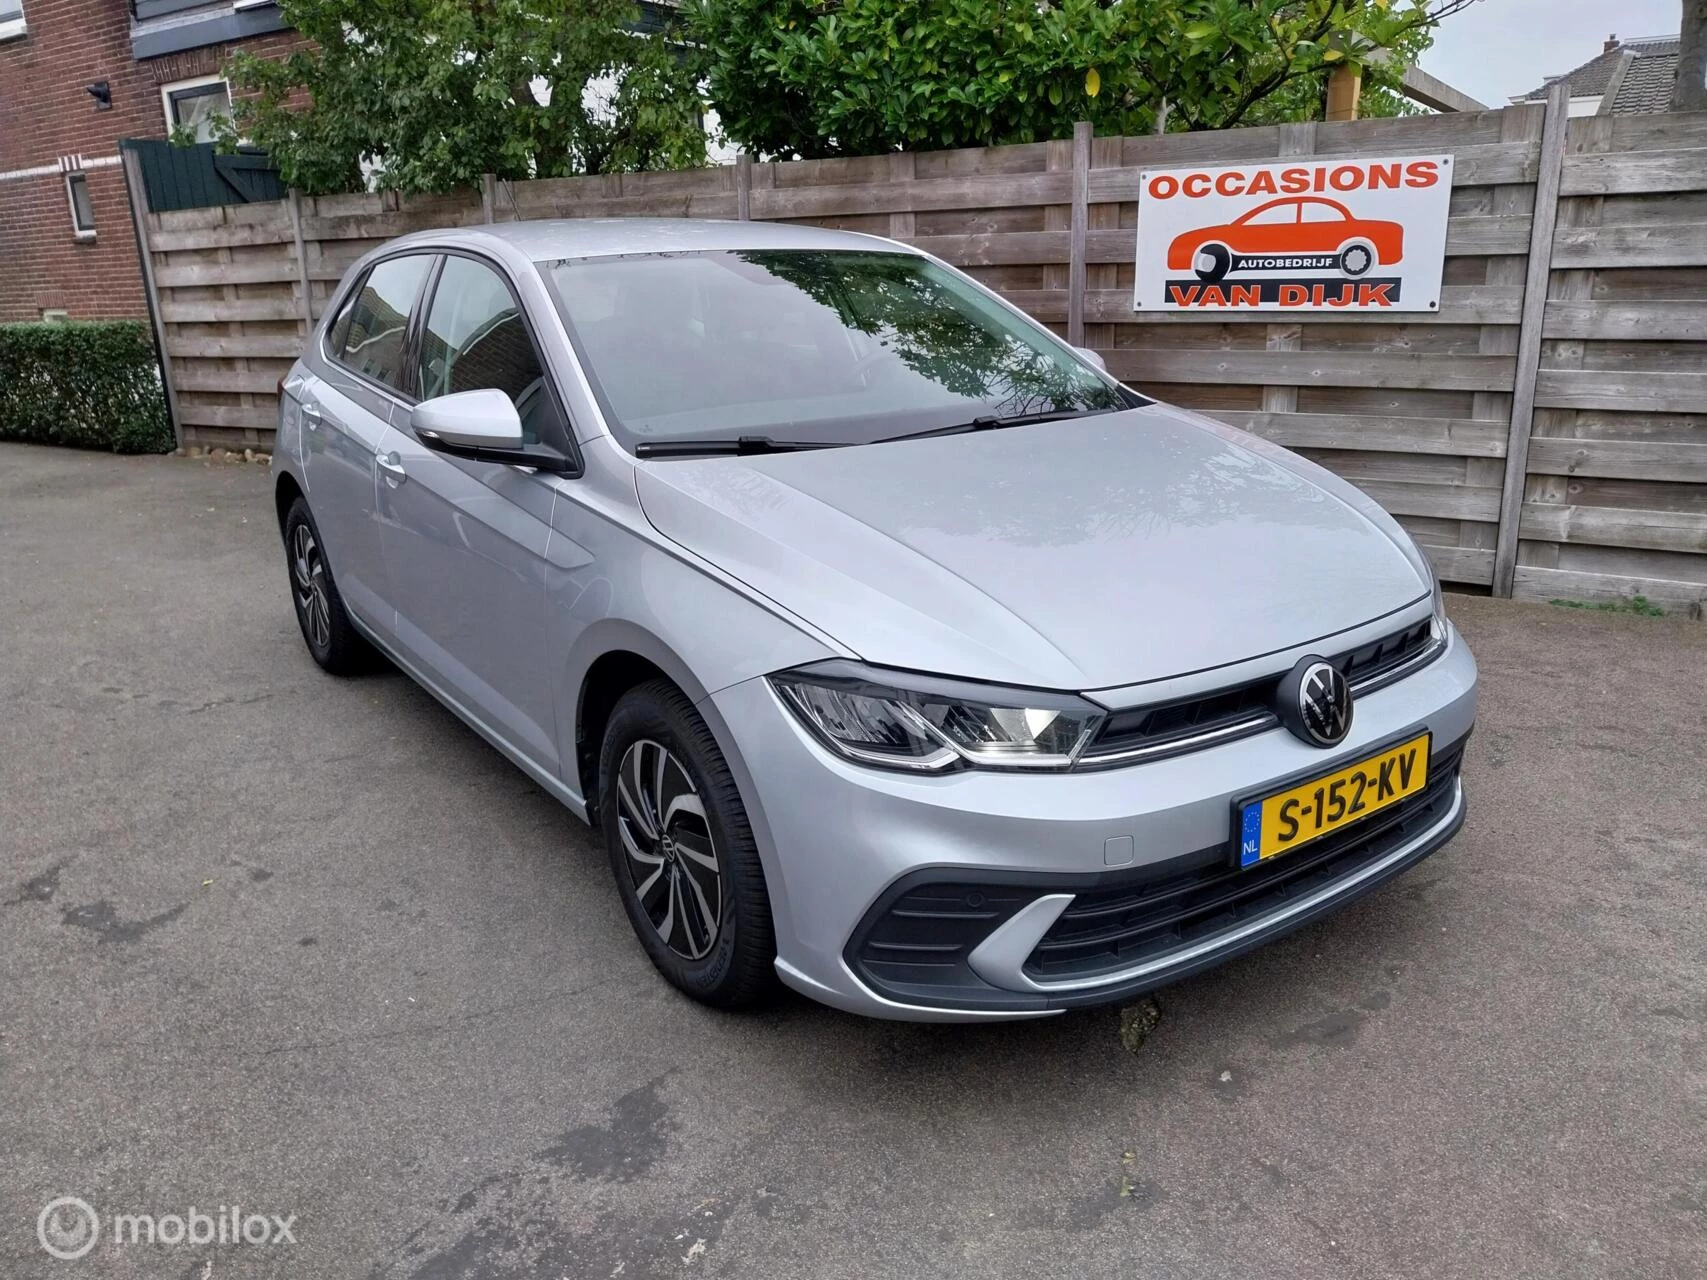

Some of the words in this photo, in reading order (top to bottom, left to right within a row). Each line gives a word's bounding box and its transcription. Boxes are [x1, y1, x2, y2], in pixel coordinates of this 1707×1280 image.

[1148, 161, 1439, 200] OCCASIONS
[1237, 257, 1333, 270] AUTOBEDRIJF
[1169, 284, 1261, 307] VAN
[1278, 283, 1396, 307] DIJK
[1277, 748, 1417, 842] S-152-KV
[1242, 839, 1258, 856] NL
